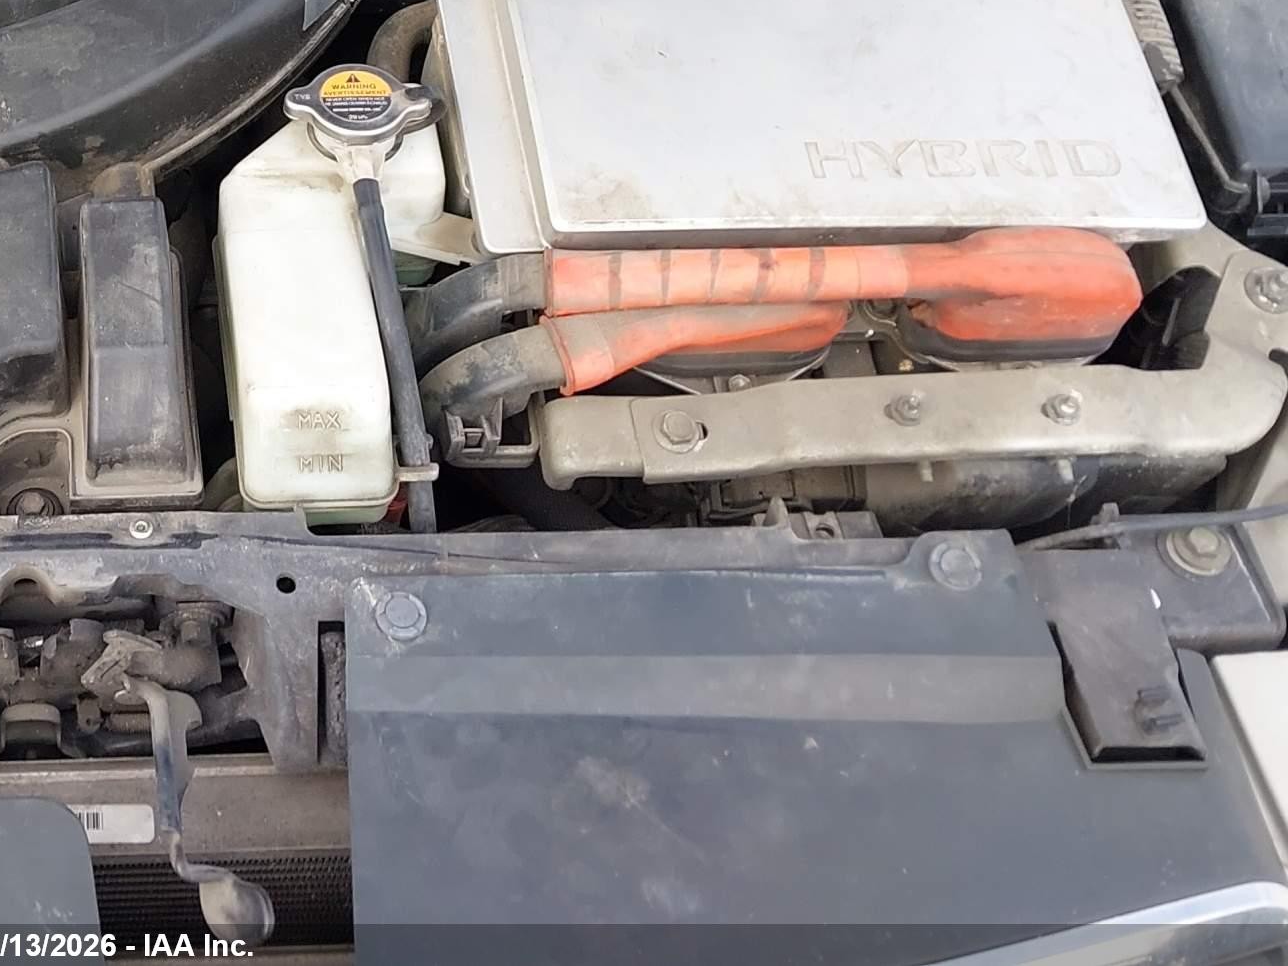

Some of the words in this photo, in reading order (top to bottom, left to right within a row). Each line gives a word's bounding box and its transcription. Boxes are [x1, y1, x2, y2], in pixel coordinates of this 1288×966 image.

[804, 138, 1122, 180] HYBRID
[297, 410, 342, 430] MAX
[298, 454, 343, 473] MIN
